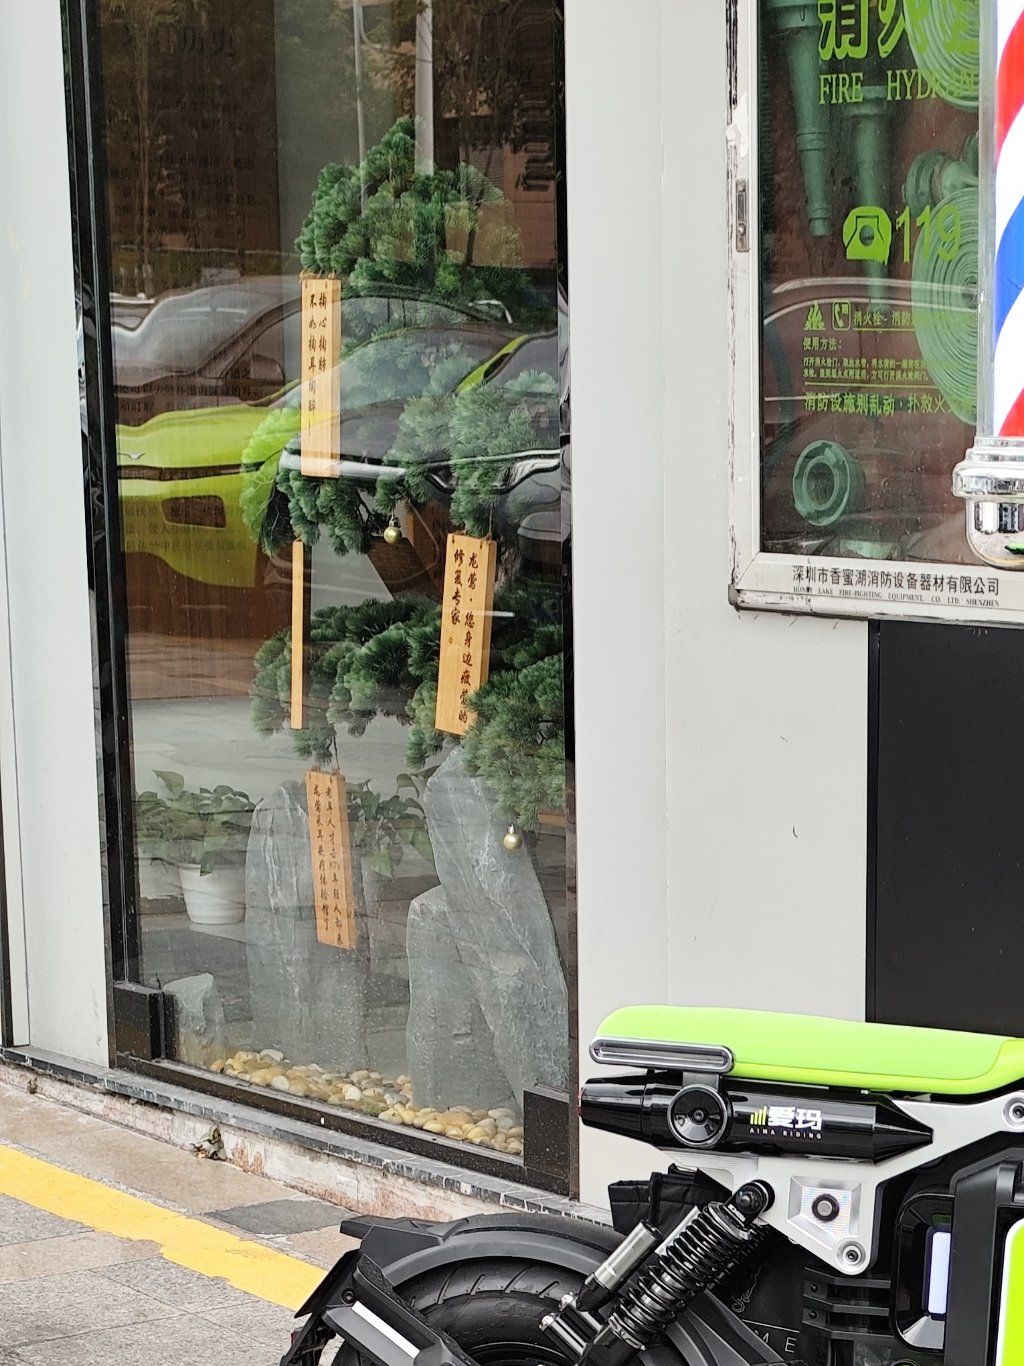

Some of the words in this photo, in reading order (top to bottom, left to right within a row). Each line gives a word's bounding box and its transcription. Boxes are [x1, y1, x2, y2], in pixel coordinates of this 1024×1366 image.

[819, 72, 864, 105] FIRE
[895, 205, 962, 264] 119
[792, 563, 1000, 596] 深圳市香蜜湖消防设备器材有限公司
[749, 1127, 776, 1136] AIMA
[782, 1130, 822, 1139] RIDING
